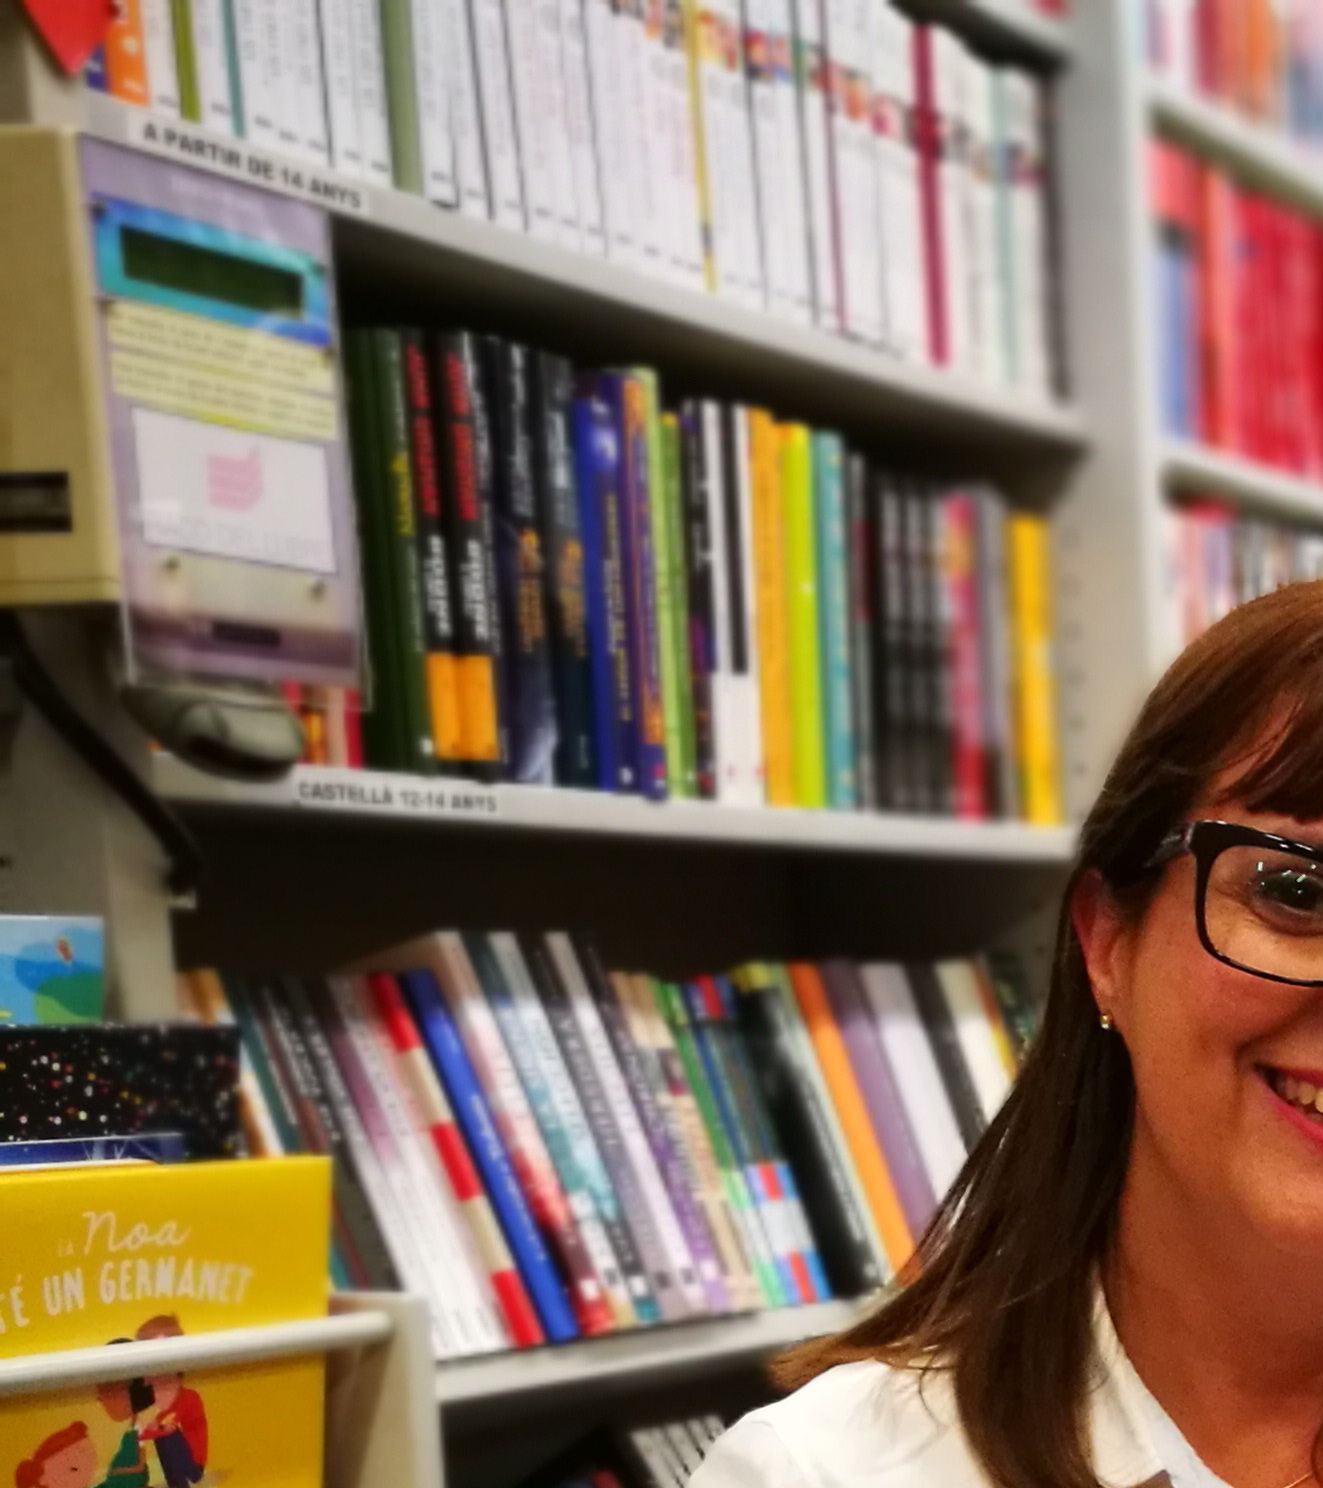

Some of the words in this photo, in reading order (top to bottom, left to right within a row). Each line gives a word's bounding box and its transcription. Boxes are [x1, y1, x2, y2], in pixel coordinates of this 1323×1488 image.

[143, 122, 157, 141] A
[164, 128, 241, 168] PARTIR
[248, 156, 274, 180] DE
[281, 167, 303, 188] 14
[309, 177, 361, 208] ANYS
[400, 790, 446, 809] 12-14
[451, 794, 498, 813] ANYS
[82, 1211, 192, 1255] Noa
[42, 1267, 84, 1317] UN
[99, 1256, 254, 1305] GERMANET
